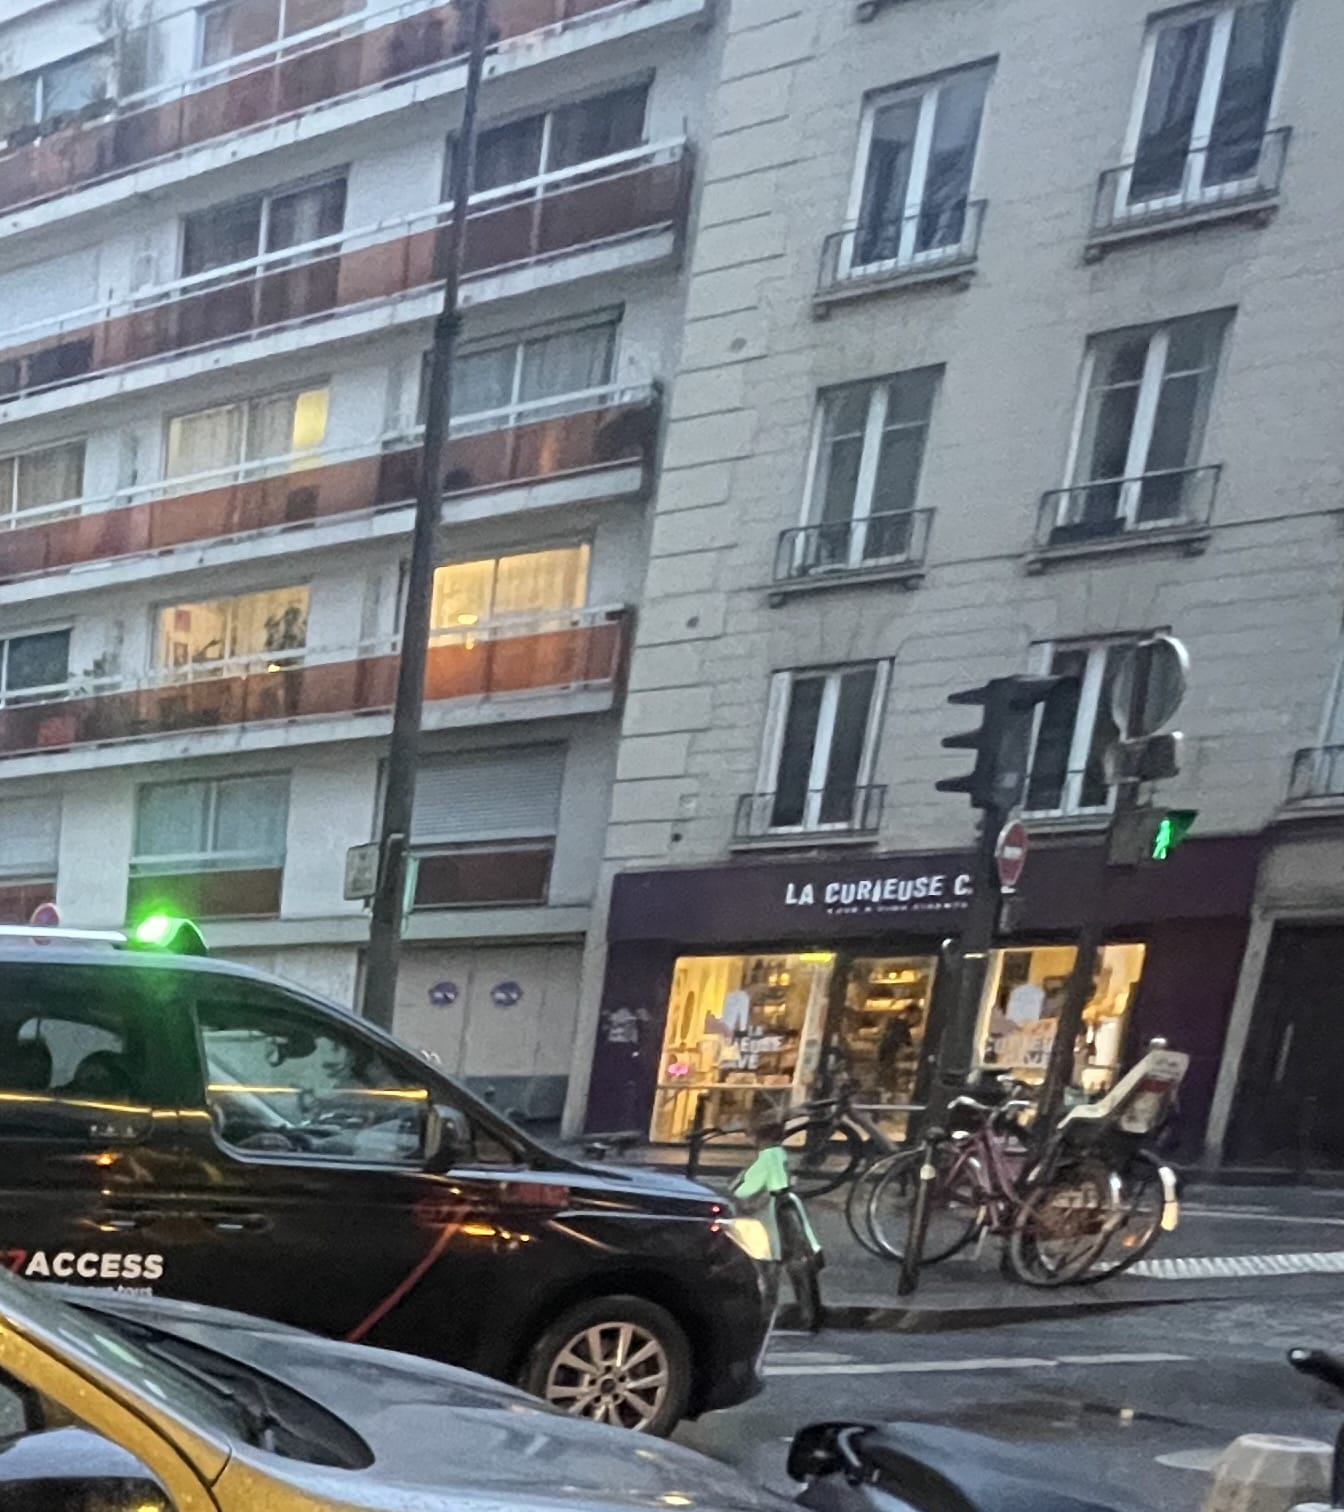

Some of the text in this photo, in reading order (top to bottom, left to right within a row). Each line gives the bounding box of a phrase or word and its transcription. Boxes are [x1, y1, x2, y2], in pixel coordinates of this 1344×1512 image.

[785, 883, 815, 905] LA
[824, 875, 947, 904] CURIEUSE
[25, 1251, 164, 1279] ACCESS
